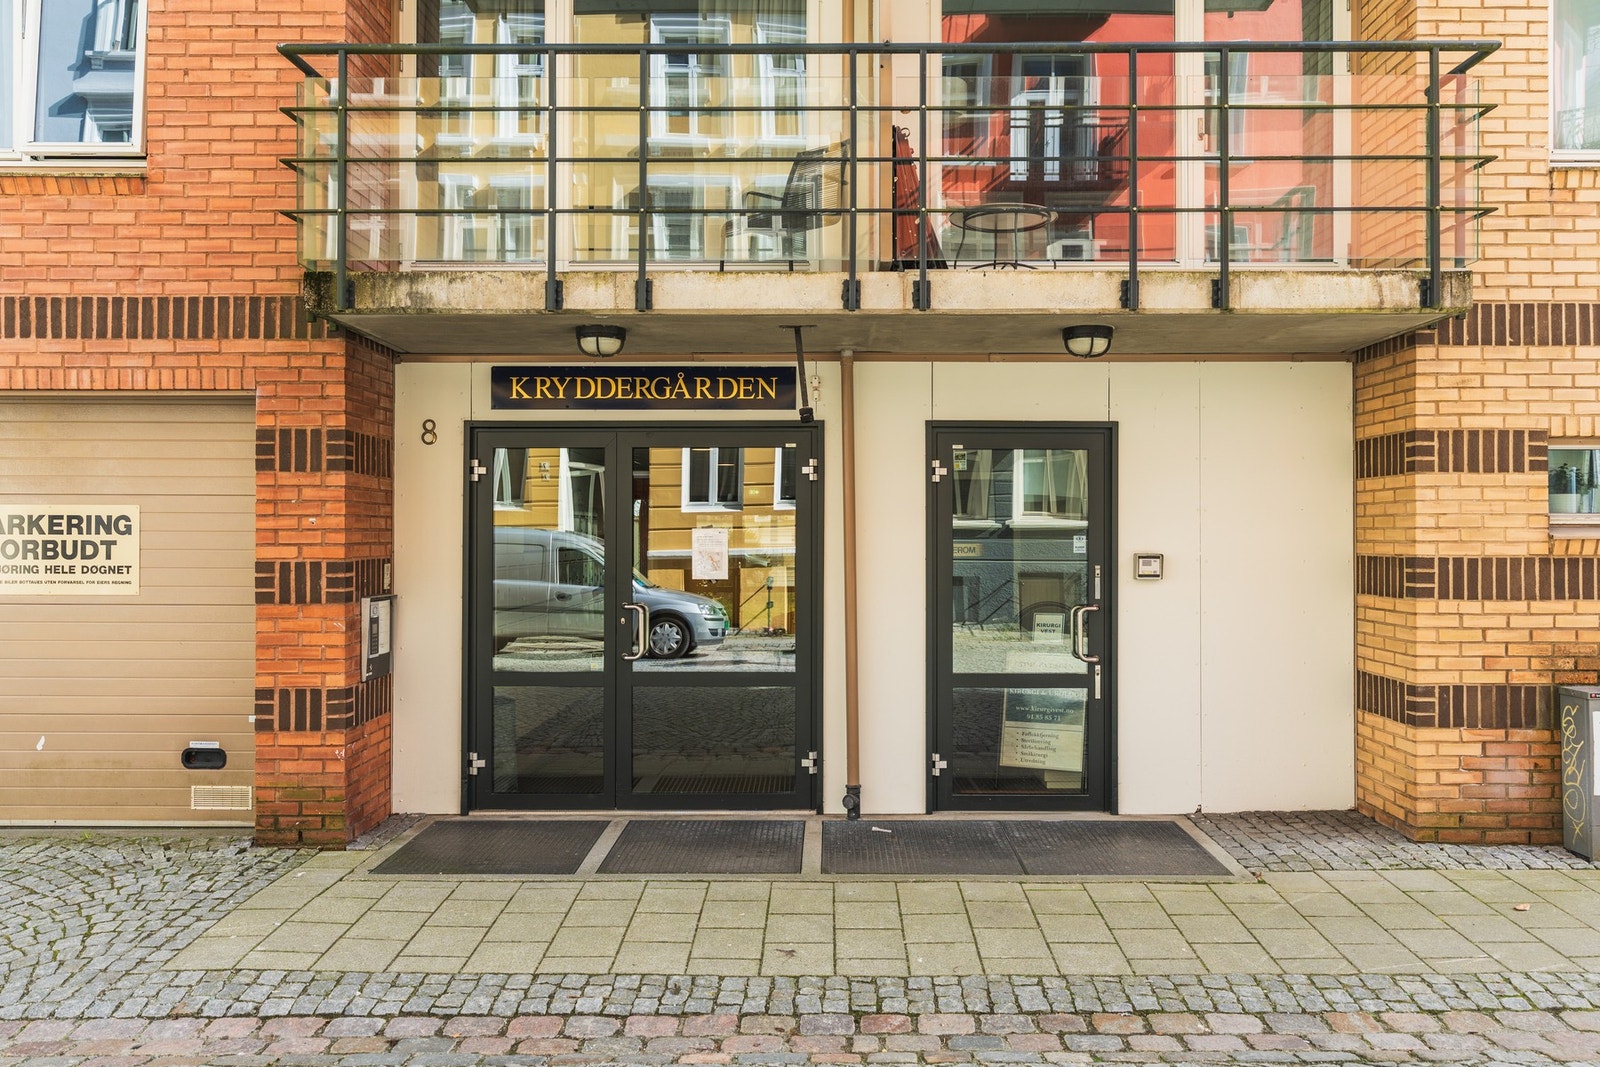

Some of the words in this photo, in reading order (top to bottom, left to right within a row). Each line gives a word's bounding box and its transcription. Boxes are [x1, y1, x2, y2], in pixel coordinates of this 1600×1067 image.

[509, 372, 778, 400] KRYDDERGÅRDEN
[421, 419, 437, 445] 8
[0, 514, 132, 535] RKERING
[0, 565, 39, 575] ØRING
[45, 565, 76, 575] HELE
[81, 565, 132, 575] DØGNET
